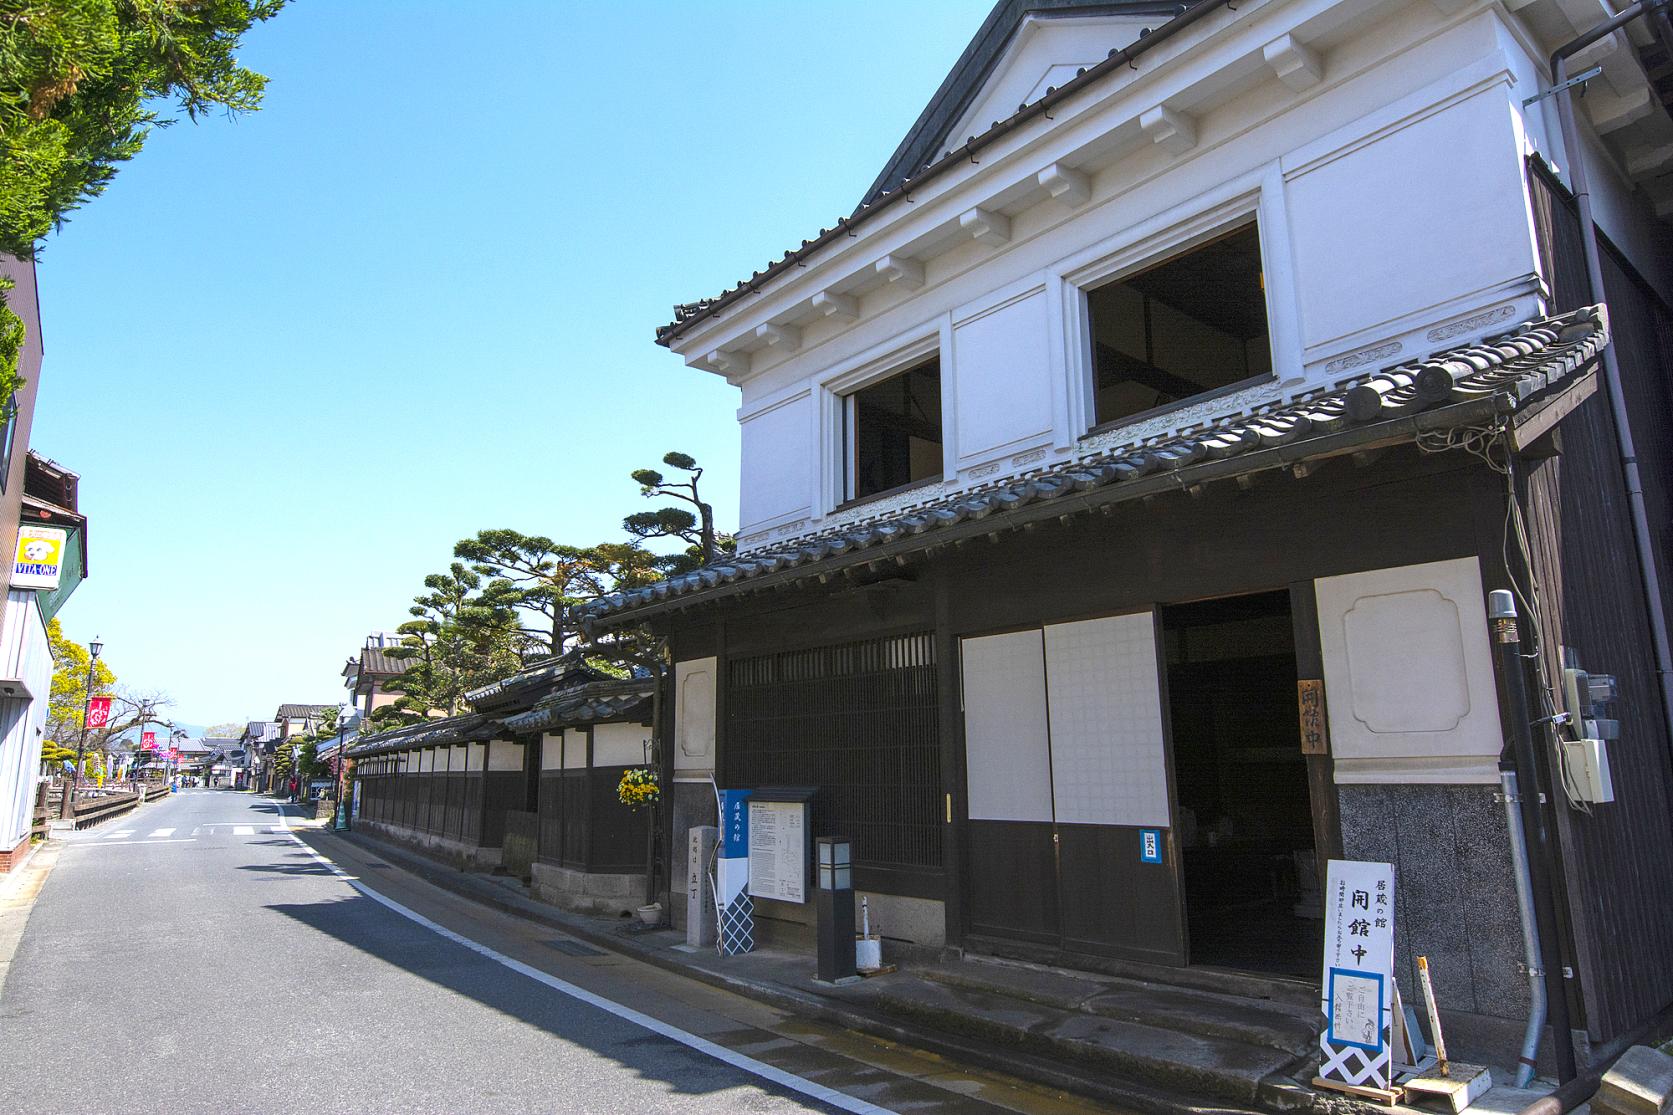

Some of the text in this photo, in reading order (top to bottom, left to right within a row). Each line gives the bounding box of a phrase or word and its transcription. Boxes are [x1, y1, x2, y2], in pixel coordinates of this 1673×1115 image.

[1348, 889, 1371, 966] 開館中
[1374, 880, 1387, 928] 居蔵の館
